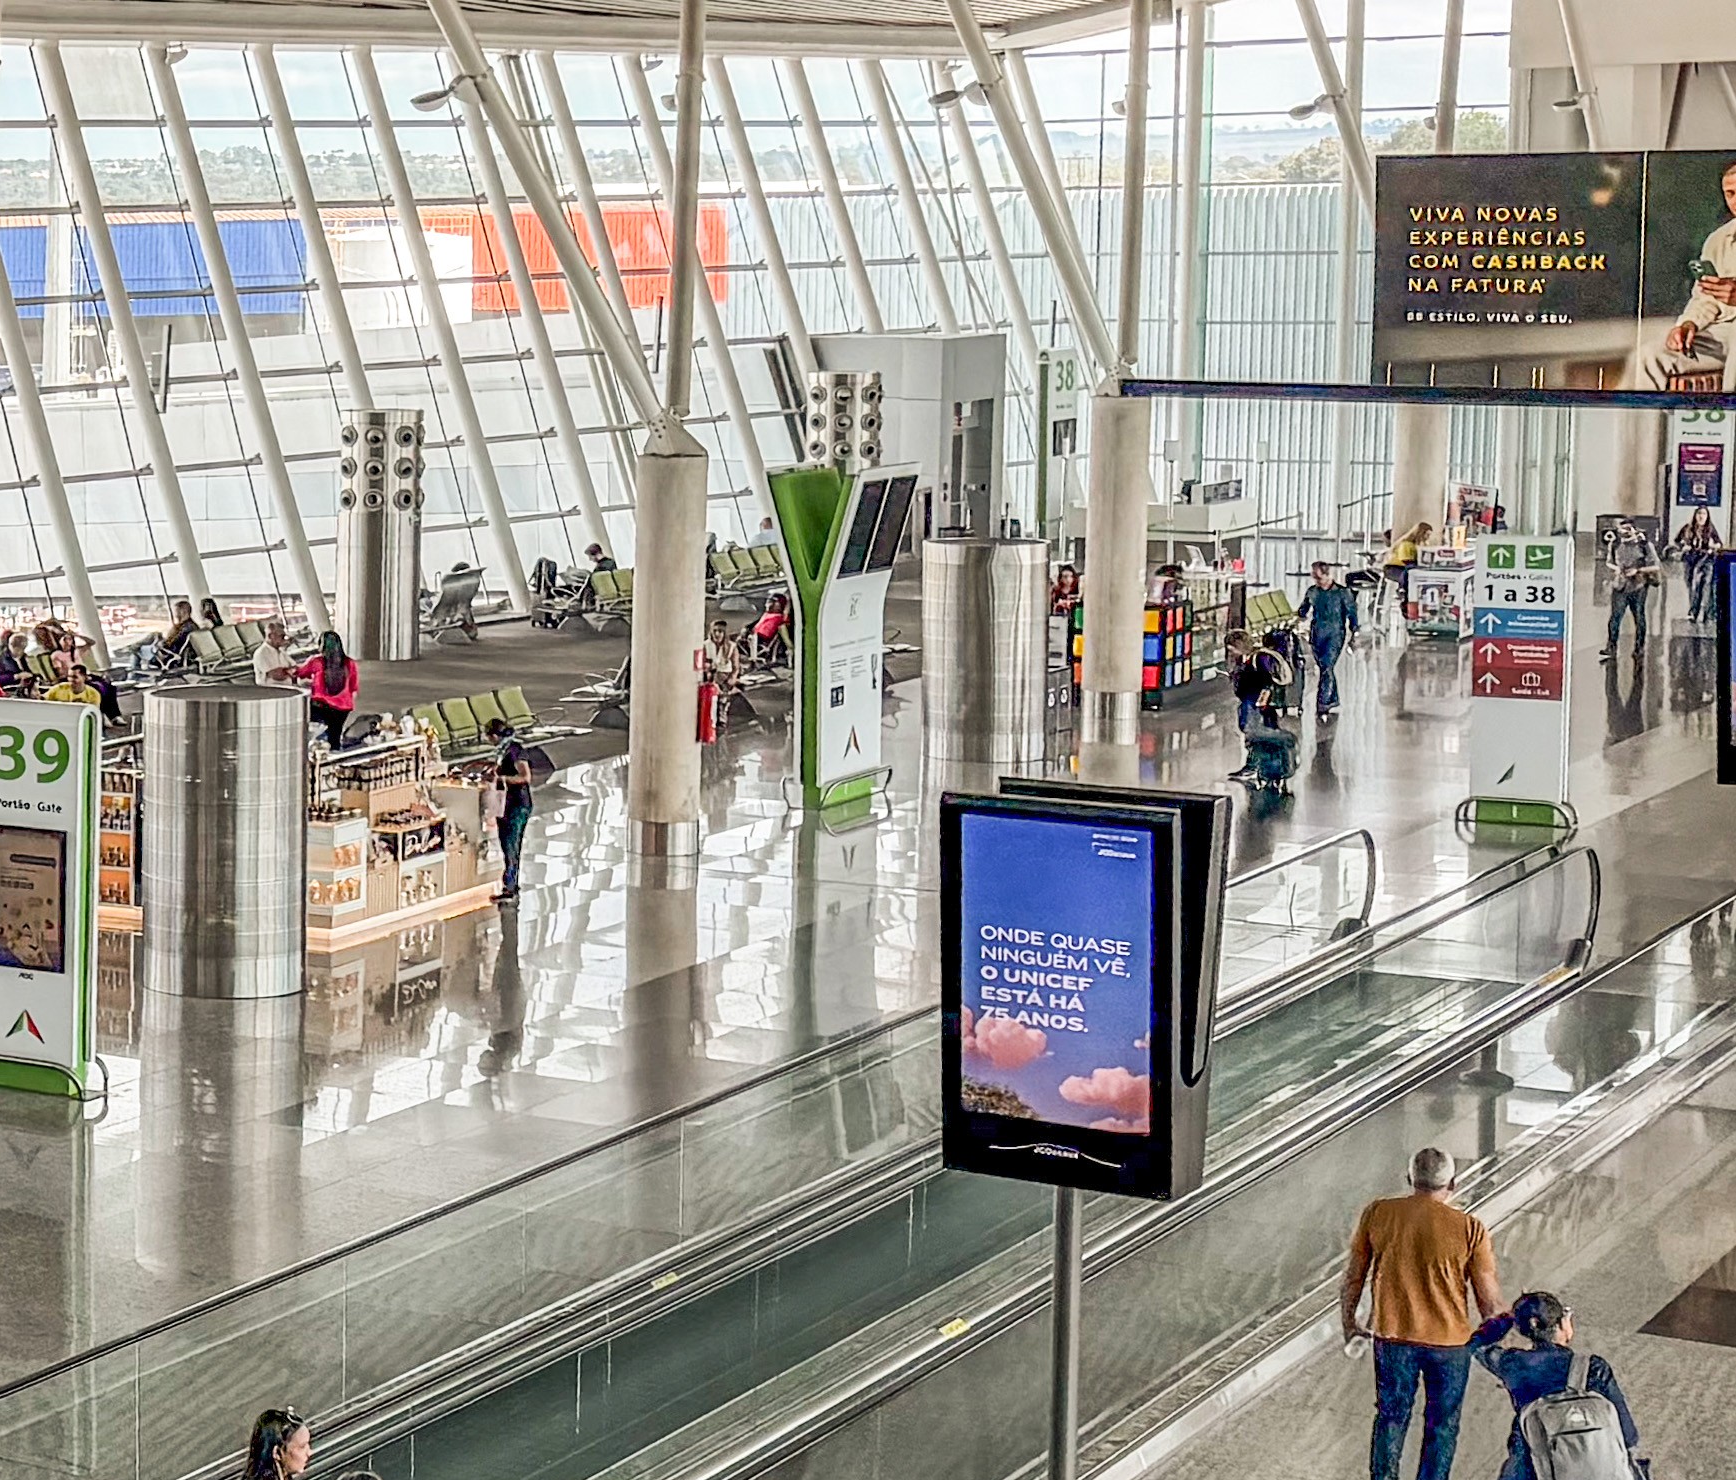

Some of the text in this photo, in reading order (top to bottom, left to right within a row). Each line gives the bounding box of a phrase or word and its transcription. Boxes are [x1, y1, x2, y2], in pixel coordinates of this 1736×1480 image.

[1409, 207, 1558, 222] VIVA NOVAS
[1409, 228, 1586, 246] EXPERIÊNCIAS
[1409, 254, 1607, 270] COM CASHBACK
[1408, 277, 1439, 292] NA
[1486, 313, 1520, 323] VIVA
[1525, 313, 1535, 323] O
[1056, 359, 1074, 392] 38
[1484, 585, 1555, 603] 1 a 38
[37, 801, 62, 814] Gate
[980, 925, 1131, 956] ONDE QUASE
[980, 945, 1088, 971] NINGUÉM
[980, 966, 1094, 991] O UNICEF
[980, 985, 1085, 1012] ESTÁ HÁ
[980, 1005, 1089, 1033] 75 ANOS.
